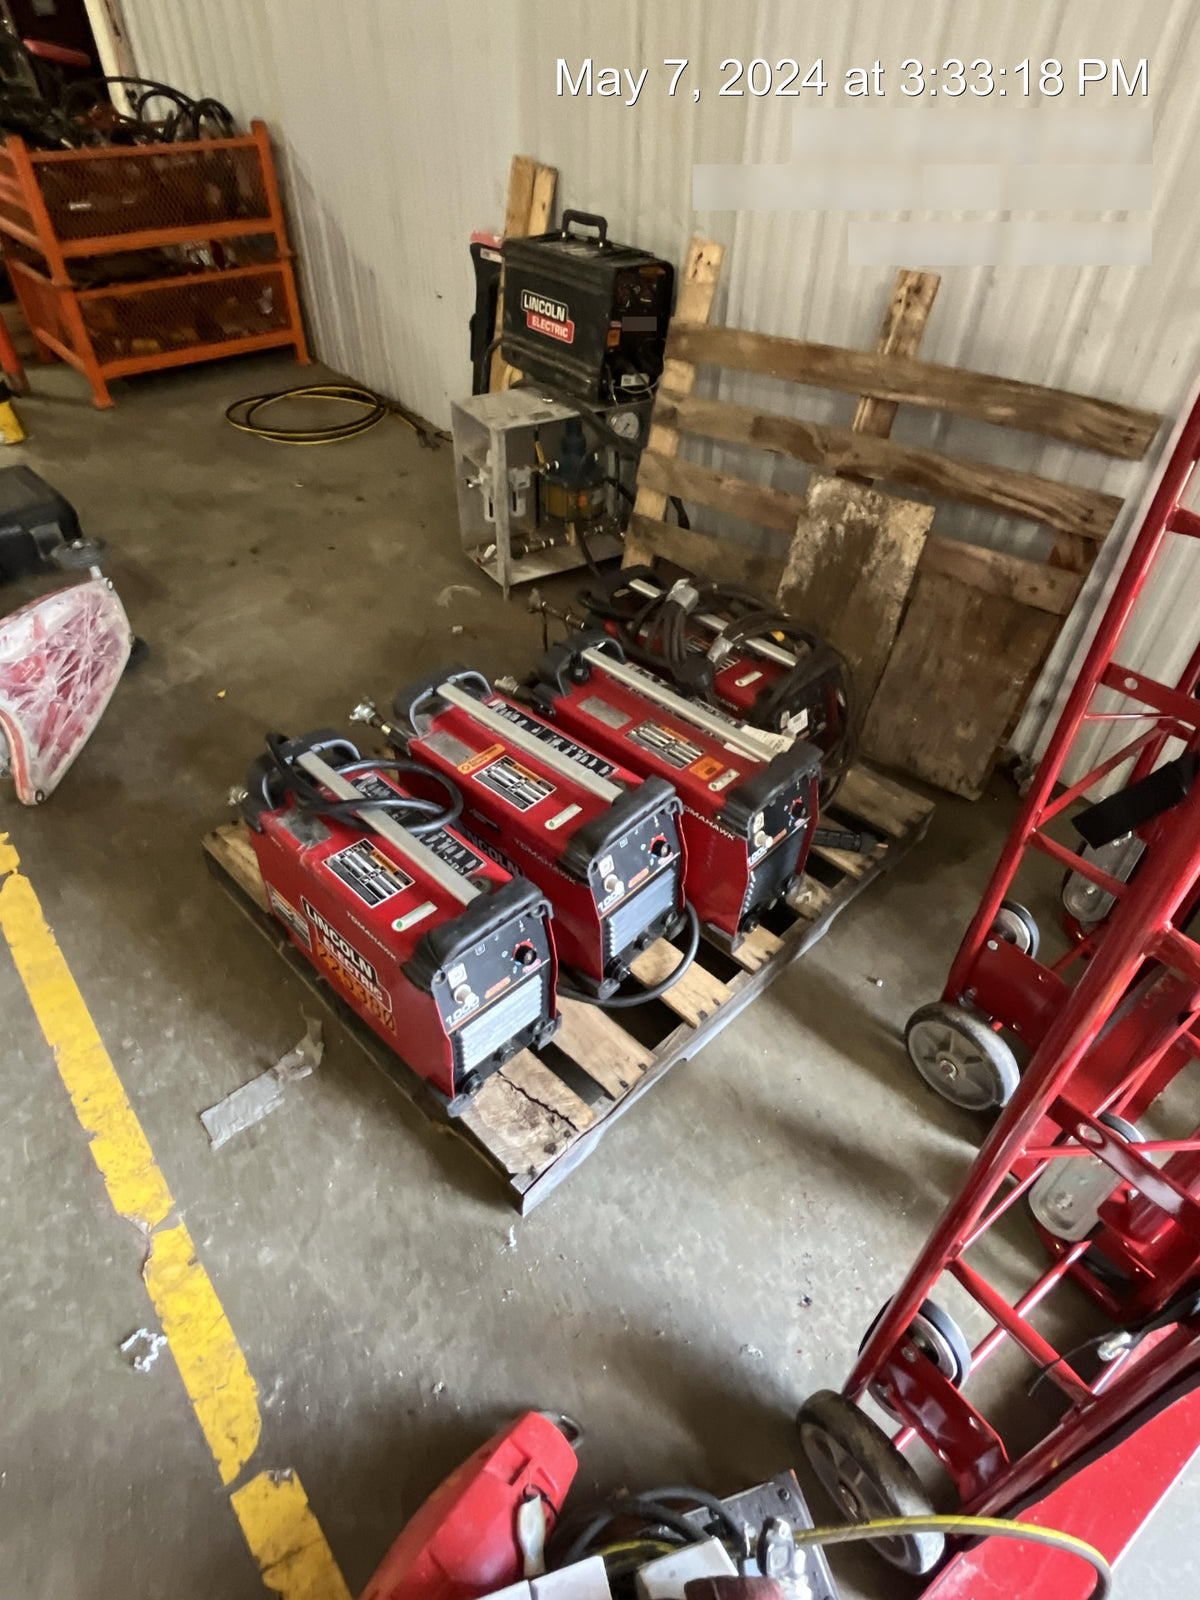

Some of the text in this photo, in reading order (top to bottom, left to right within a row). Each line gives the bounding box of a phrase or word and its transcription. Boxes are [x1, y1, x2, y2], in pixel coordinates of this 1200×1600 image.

[524, 293, 566, 322] LINCOLN
[532, 315, 569, 338] ELECTRIC
[683, 804, 735, 841] OMAHAWK
[514, 838, 577, 885] TOMAHAWK
[305, 903, 372, 980] LINCOLN
[346, 910, 397, 961] TOMAHAWK
[322, 935, 383, 1001] ELECTRIC
